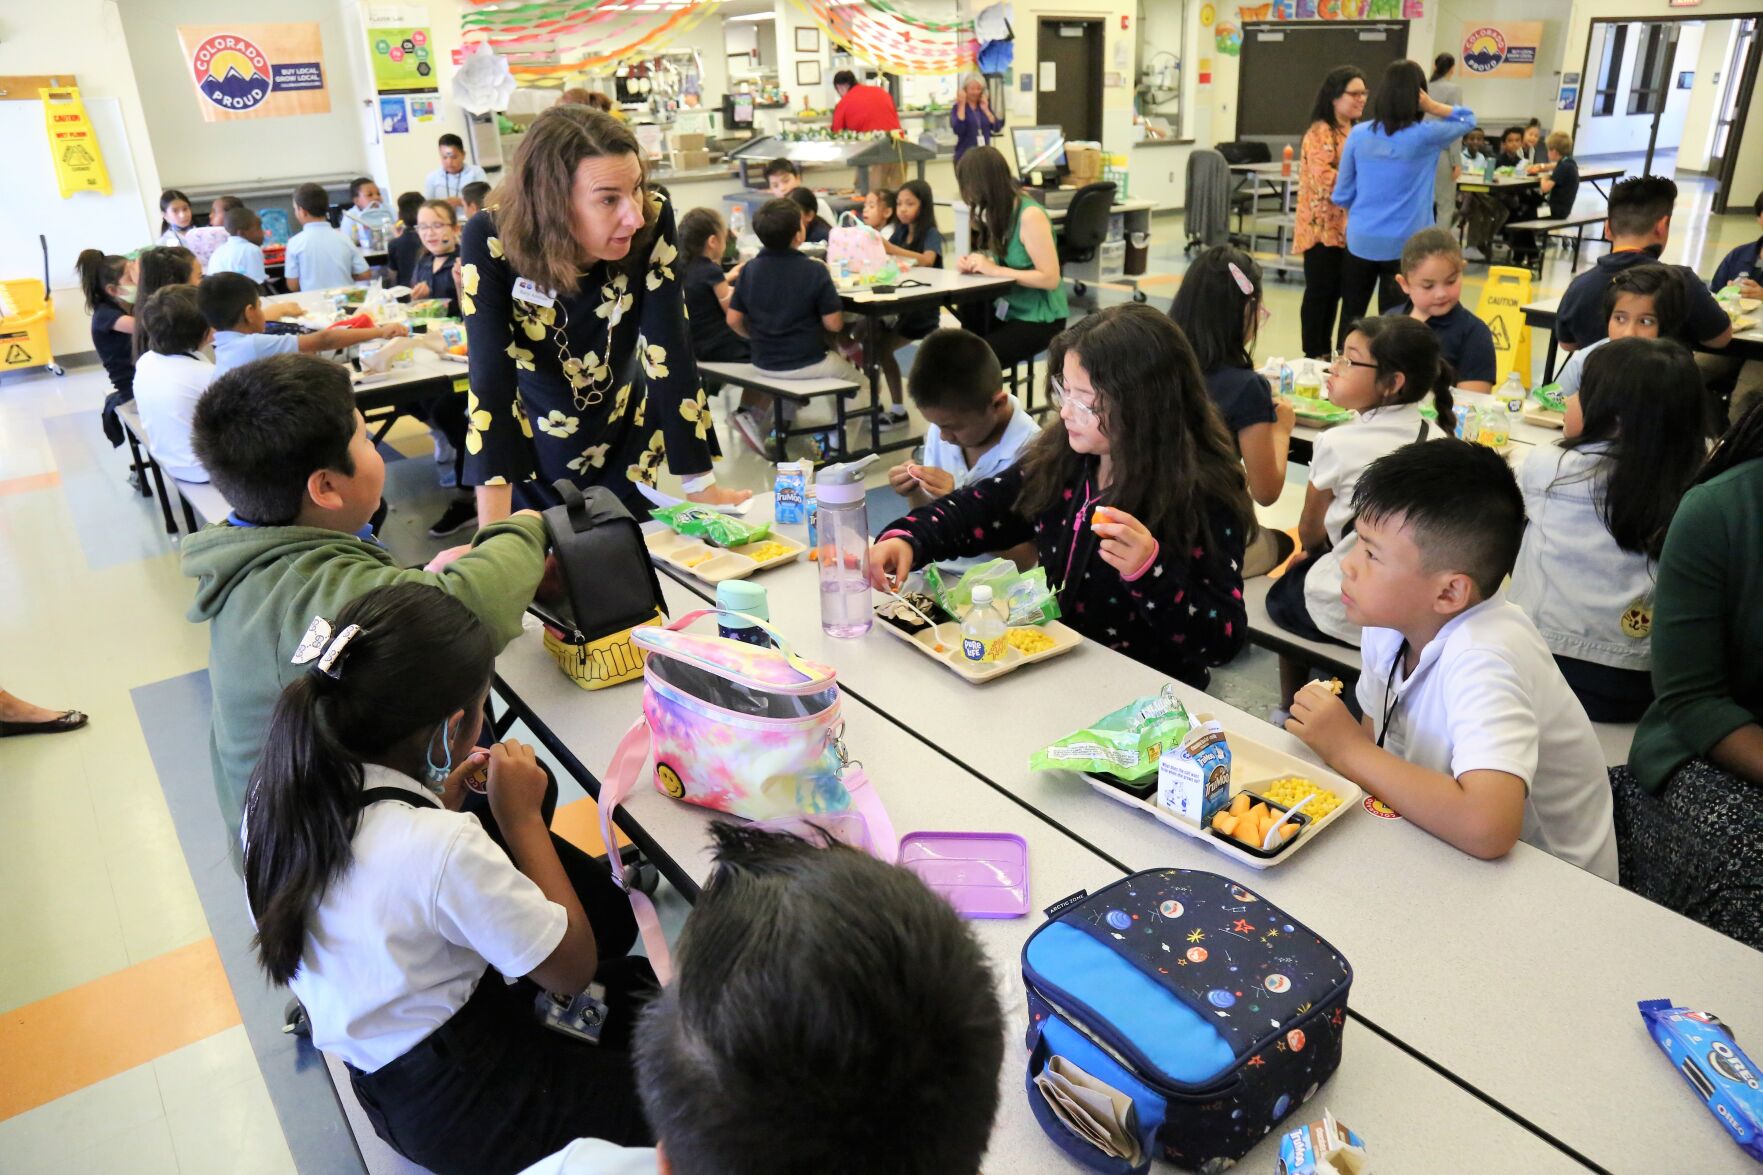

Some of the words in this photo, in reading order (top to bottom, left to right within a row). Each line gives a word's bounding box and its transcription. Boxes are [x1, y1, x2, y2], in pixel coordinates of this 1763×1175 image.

[1238, 0, 1424, 20] WELCOME
[1466, 28, 1505, 49] COLORADO
[196, 37, 264, 71] COLORADO
[1468, 60, 1497, 72] PROUD
[212, 88, 263, 108] PROUD
[1488, 296, 1519, 307] CAUTION
[776, 492, 802, 503] TruMoo
[1205, 771, 1231, 798] TruMoo
[1364, 798, 1396, 818] COLORADO
[1050, 901, 1070, 914] ARCTIC
[1070, 893, 1084, 904] ZONE
[1712, 1041, 1759, 1090] OREO
[1717, 1103, 1744, 1136] OREO
[1289, 1128, 1305, 1168] TruMoo
